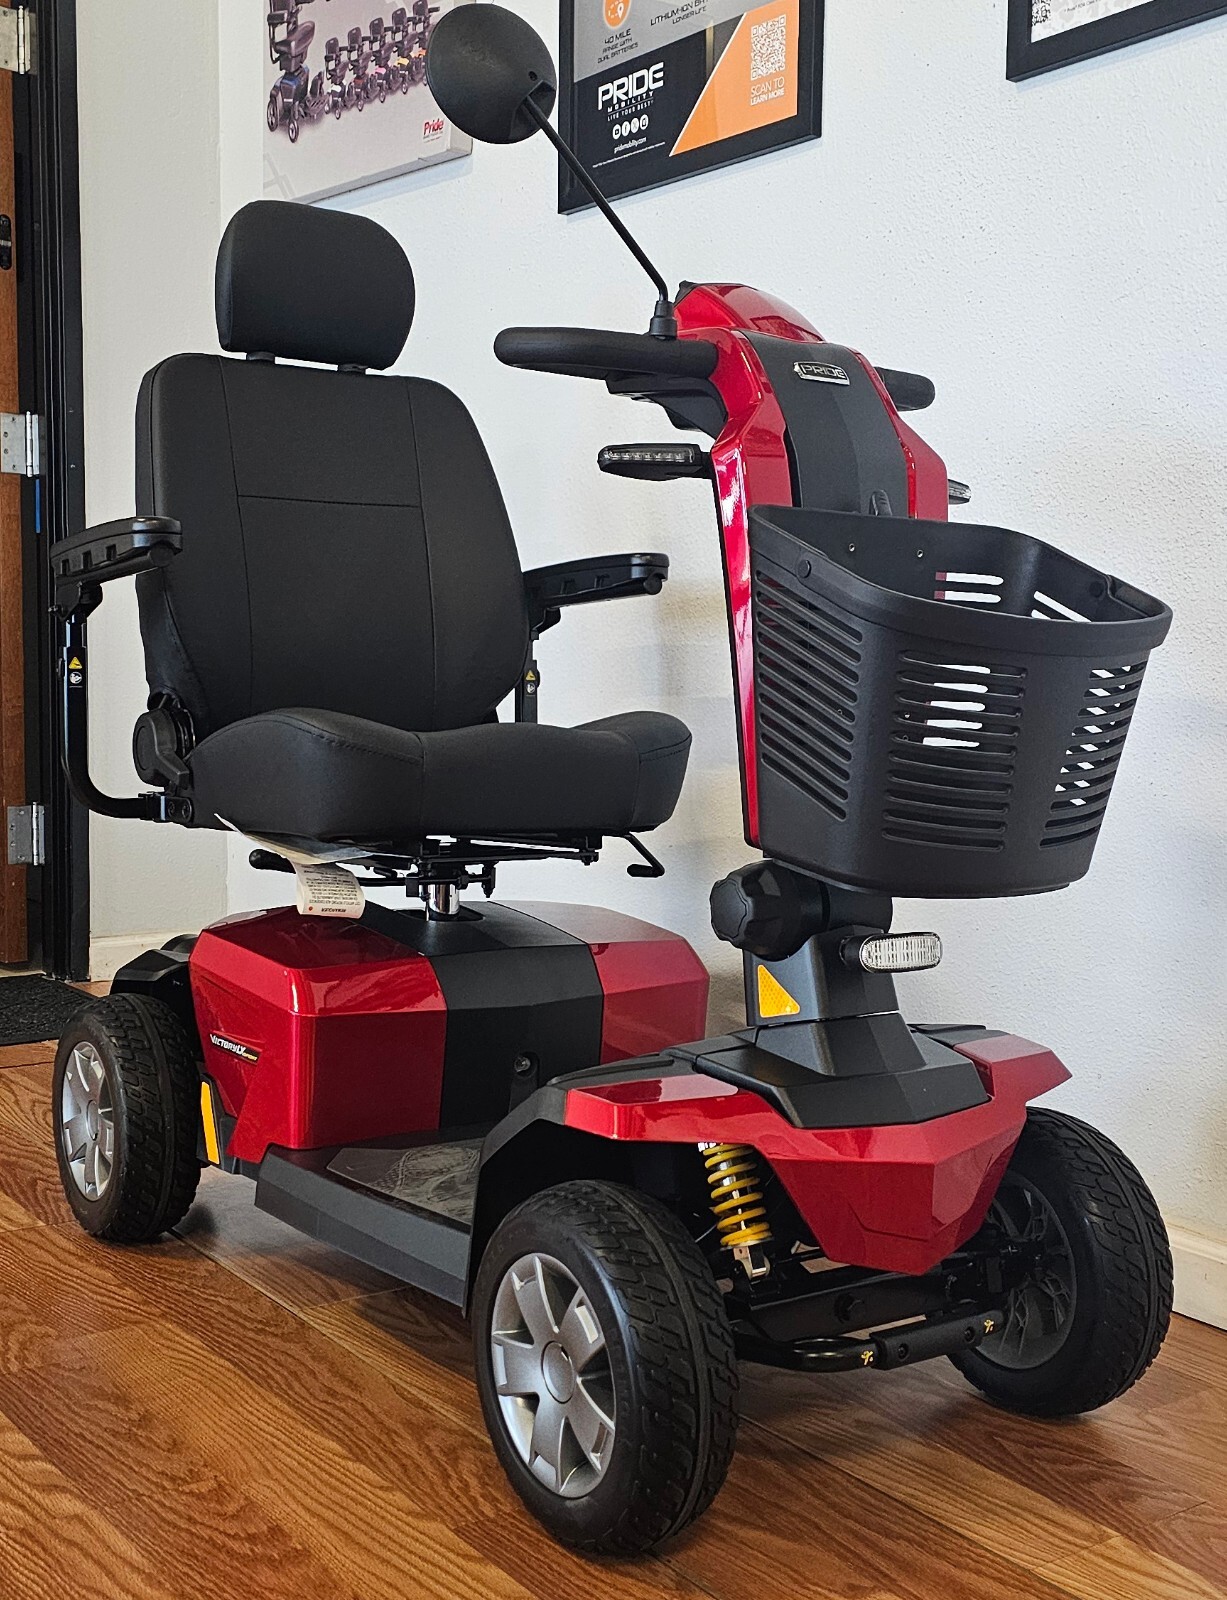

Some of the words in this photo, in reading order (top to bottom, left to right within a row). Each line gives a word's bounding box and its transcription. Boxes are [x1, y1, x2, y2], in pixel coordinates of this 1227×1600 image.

[672, 10, 695, 25] LONGER
[615, 28, 632, 41] MILE
[598, 62, 664, 110] PRIDE
[750, 79, 772, 98] SCAN
[772, 76, 785, 90] TO
[607, 91, 653, 112] MOBILITY
[750, 92, 768, 106] LEARN
[768, 87, 785, 100] MORE
[423, 117, 443, 135] Pride
[800, 364, 846, 379] PRIDE
